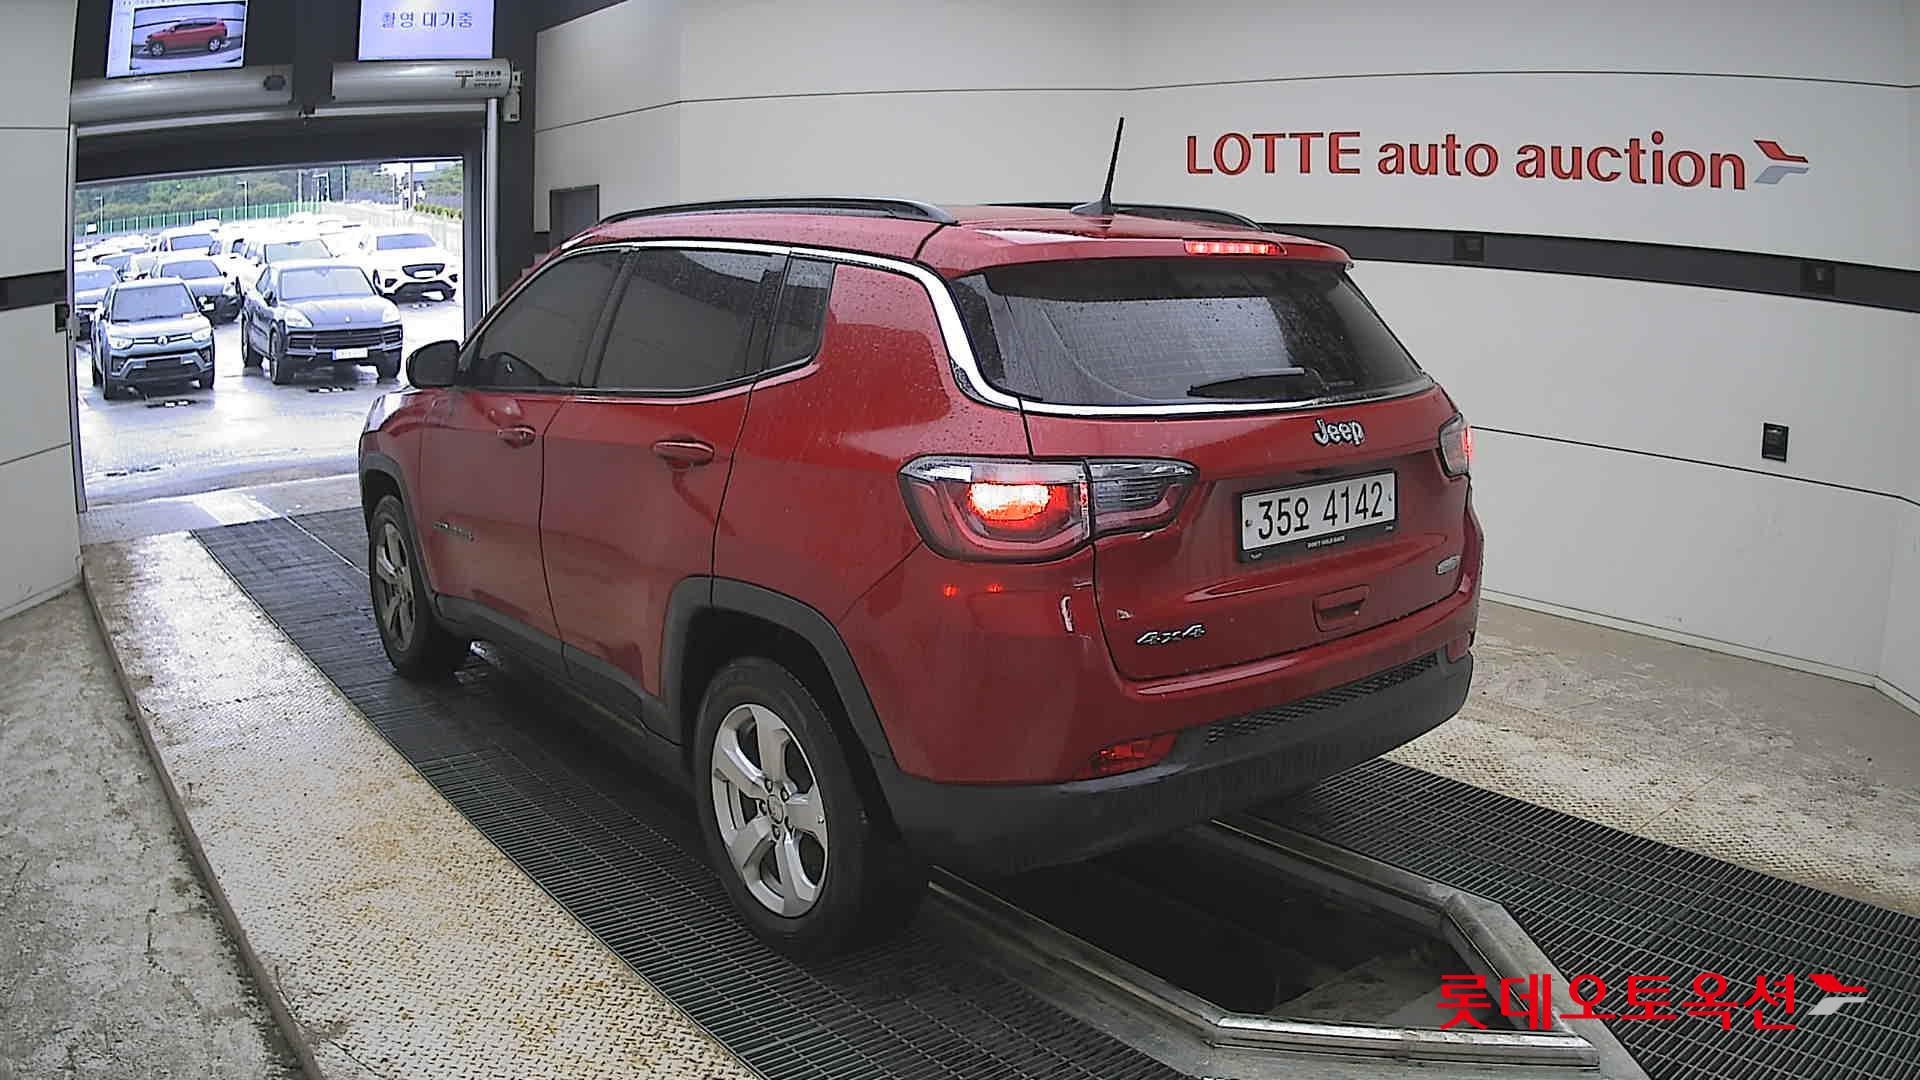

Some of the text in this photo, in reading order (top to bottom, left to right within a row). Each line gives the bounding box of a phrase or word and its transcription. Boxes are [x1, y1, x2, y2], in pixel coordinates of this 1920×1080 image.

[422, 11, 473, 28] 대기중
[1187, 130, 1746, 191] LOTTE auto auction
[1313, 418, 1365, 445] Jeep
[1258, 481, 1384, 540] 35오 4142
[1136, 624, 1205, 645] 4x4
